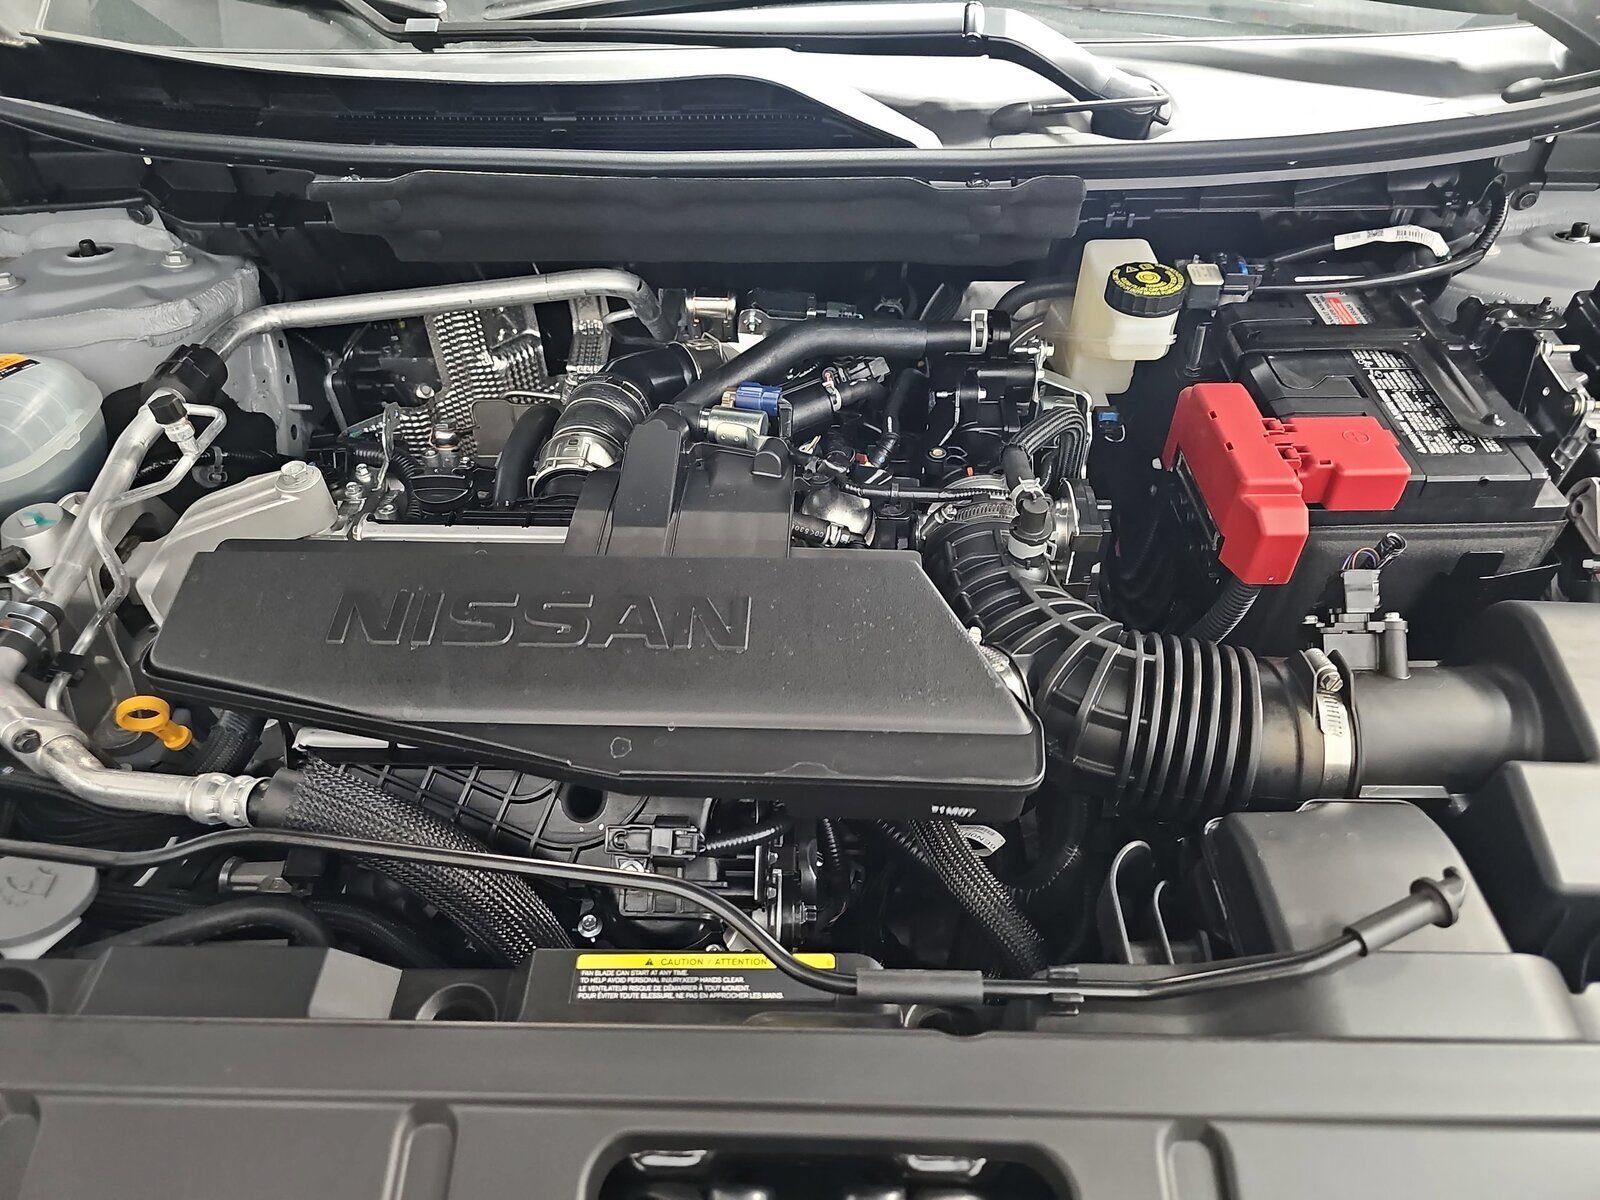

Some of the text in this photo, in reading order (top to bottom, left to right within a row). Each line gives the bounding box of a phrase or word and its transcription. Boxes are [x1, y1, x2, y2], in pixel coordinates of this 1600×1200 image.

[325, 592, 752, 650] NISSAN
[660, 958, 703, 966] CAUTION
[714, 958, 768, 966] ATTENTION
